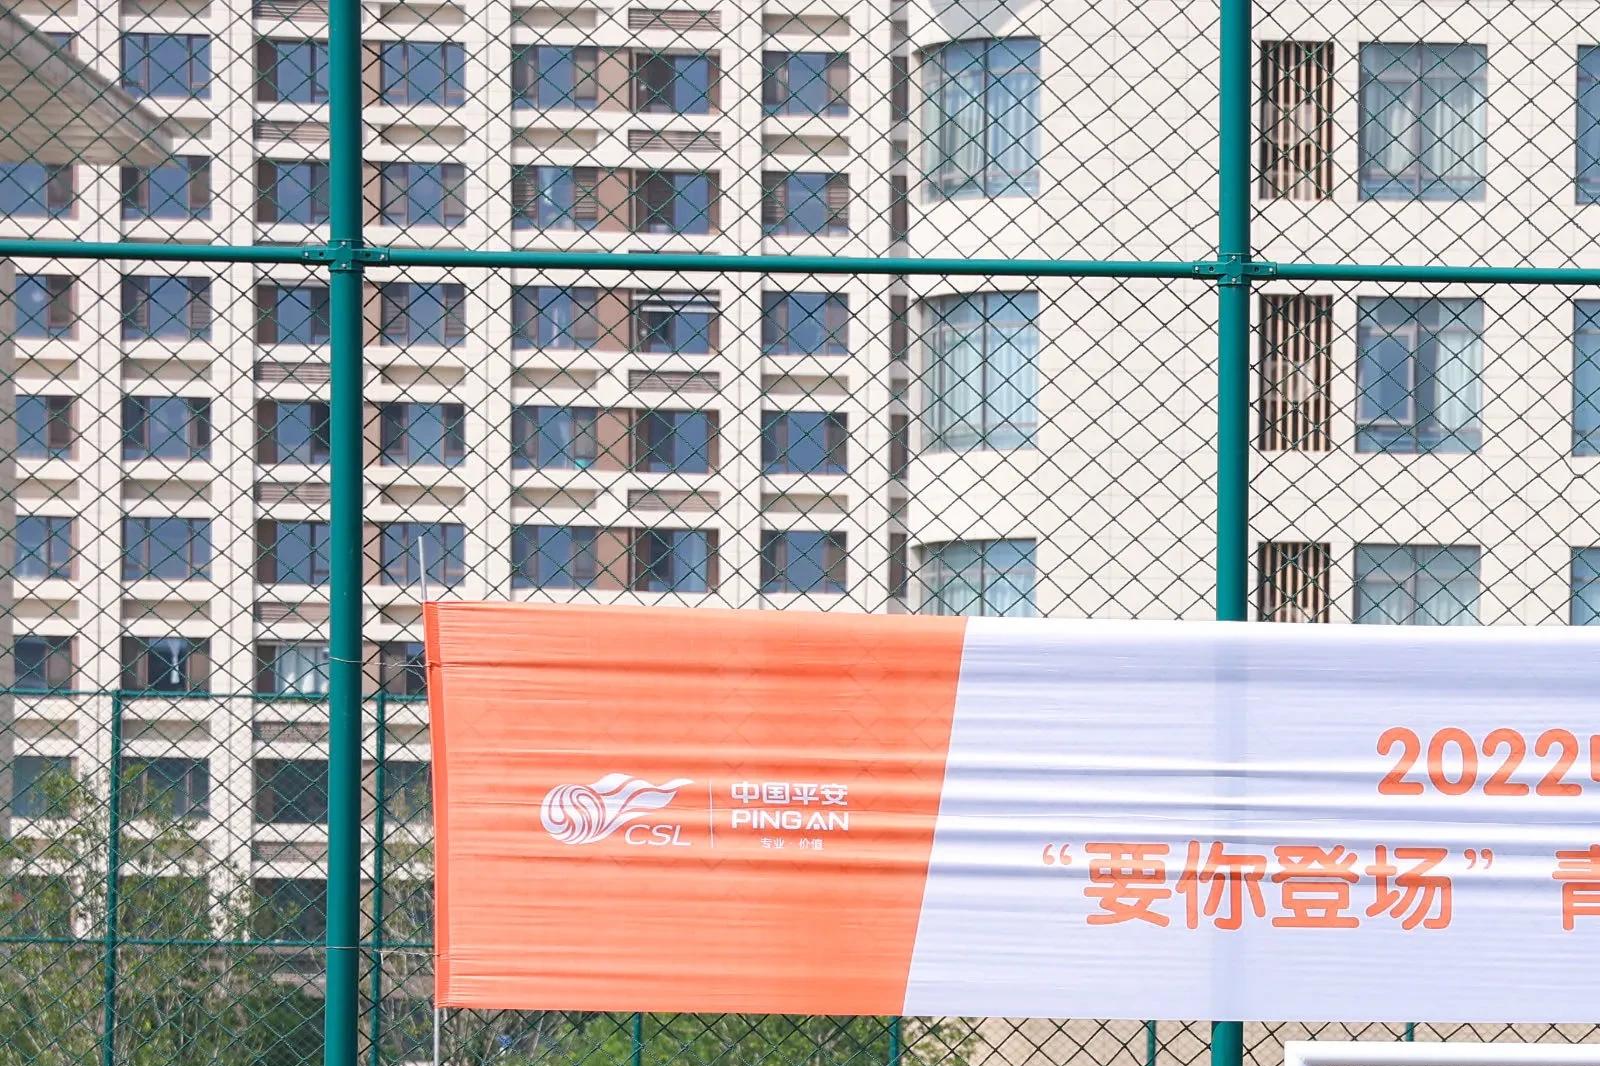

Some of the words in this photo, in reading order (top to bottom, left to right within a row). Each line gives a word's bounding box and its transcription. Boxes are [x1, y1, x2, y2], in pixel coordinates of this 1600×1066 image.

[731, 781, 848, 805] 中国平安
[624, 824, 691, 846] CSL
[1042, 840, 1493, 931] “要你登场”
